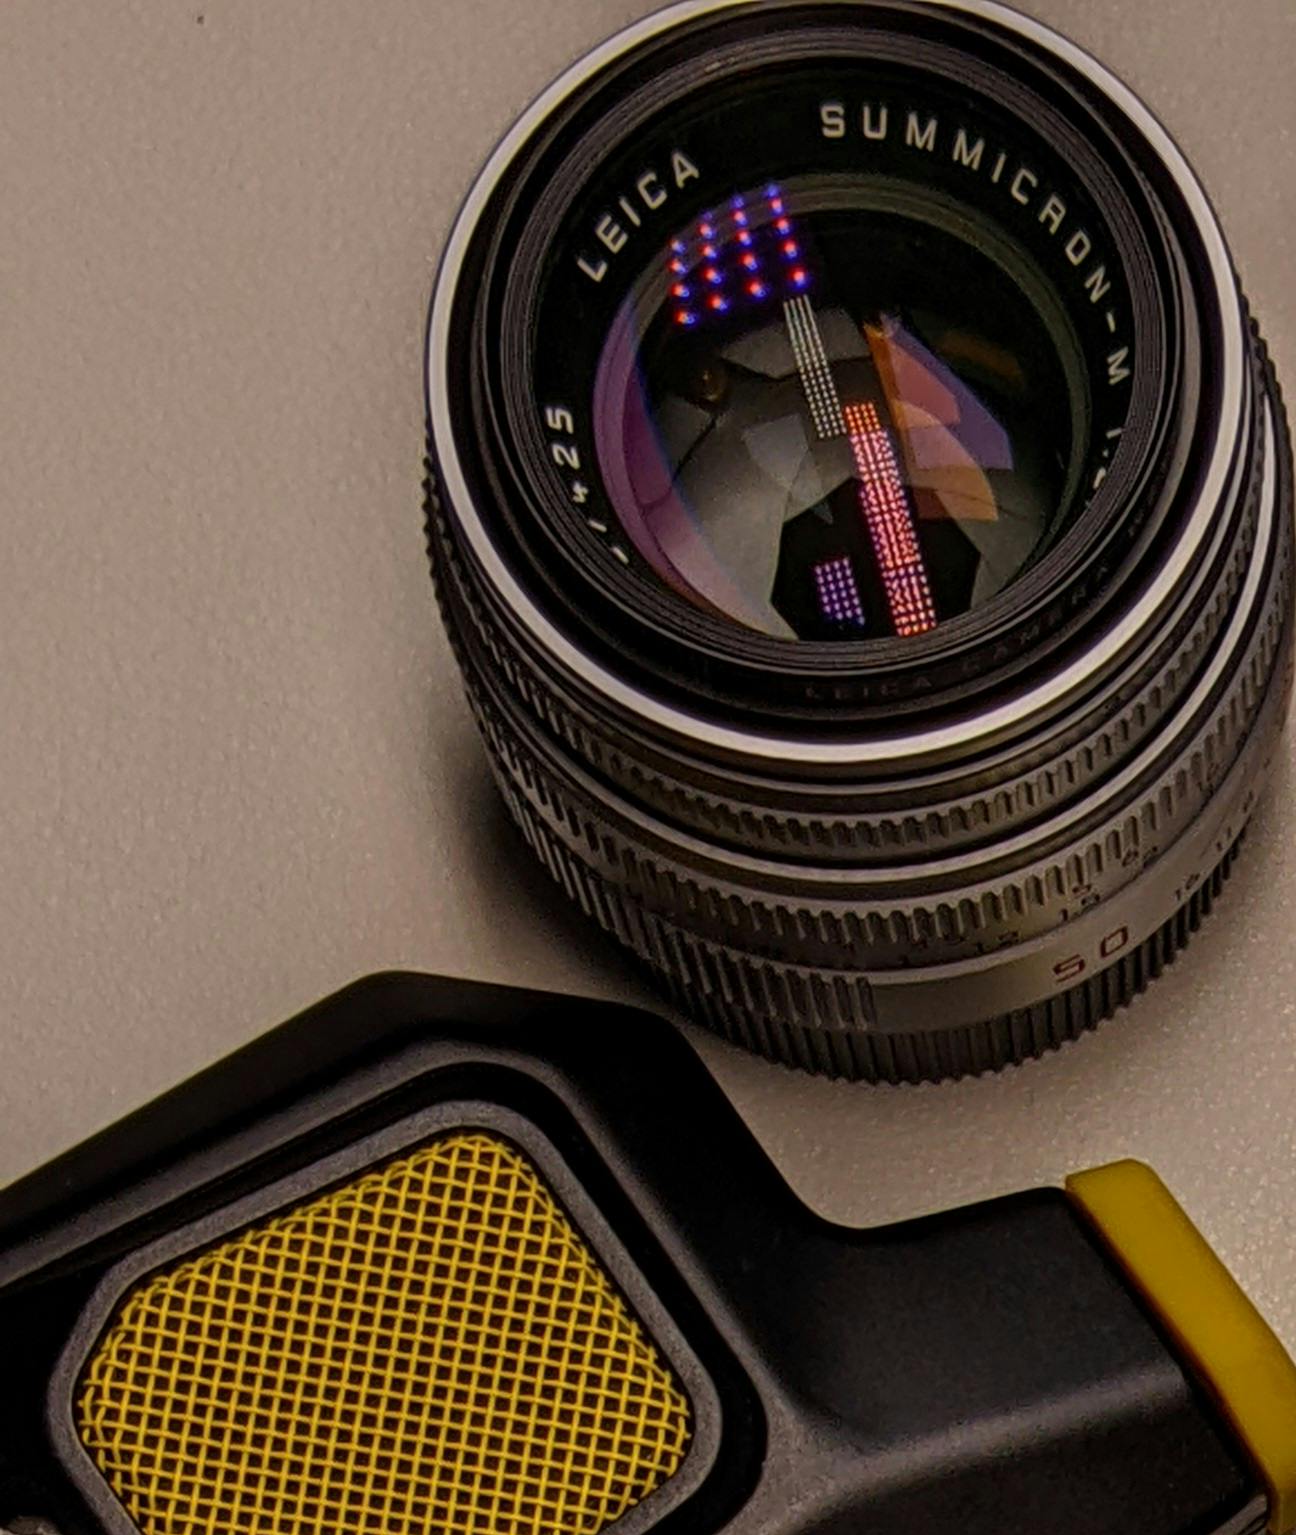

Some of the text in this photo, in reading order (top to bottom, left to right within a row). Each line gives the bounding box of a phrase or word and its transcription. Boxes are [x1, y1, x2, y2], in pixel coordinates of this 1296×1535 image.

[576, 99, 1132, 387] LEICA SUMMICRON-M
[1052, 924, 1130, 984] 50
